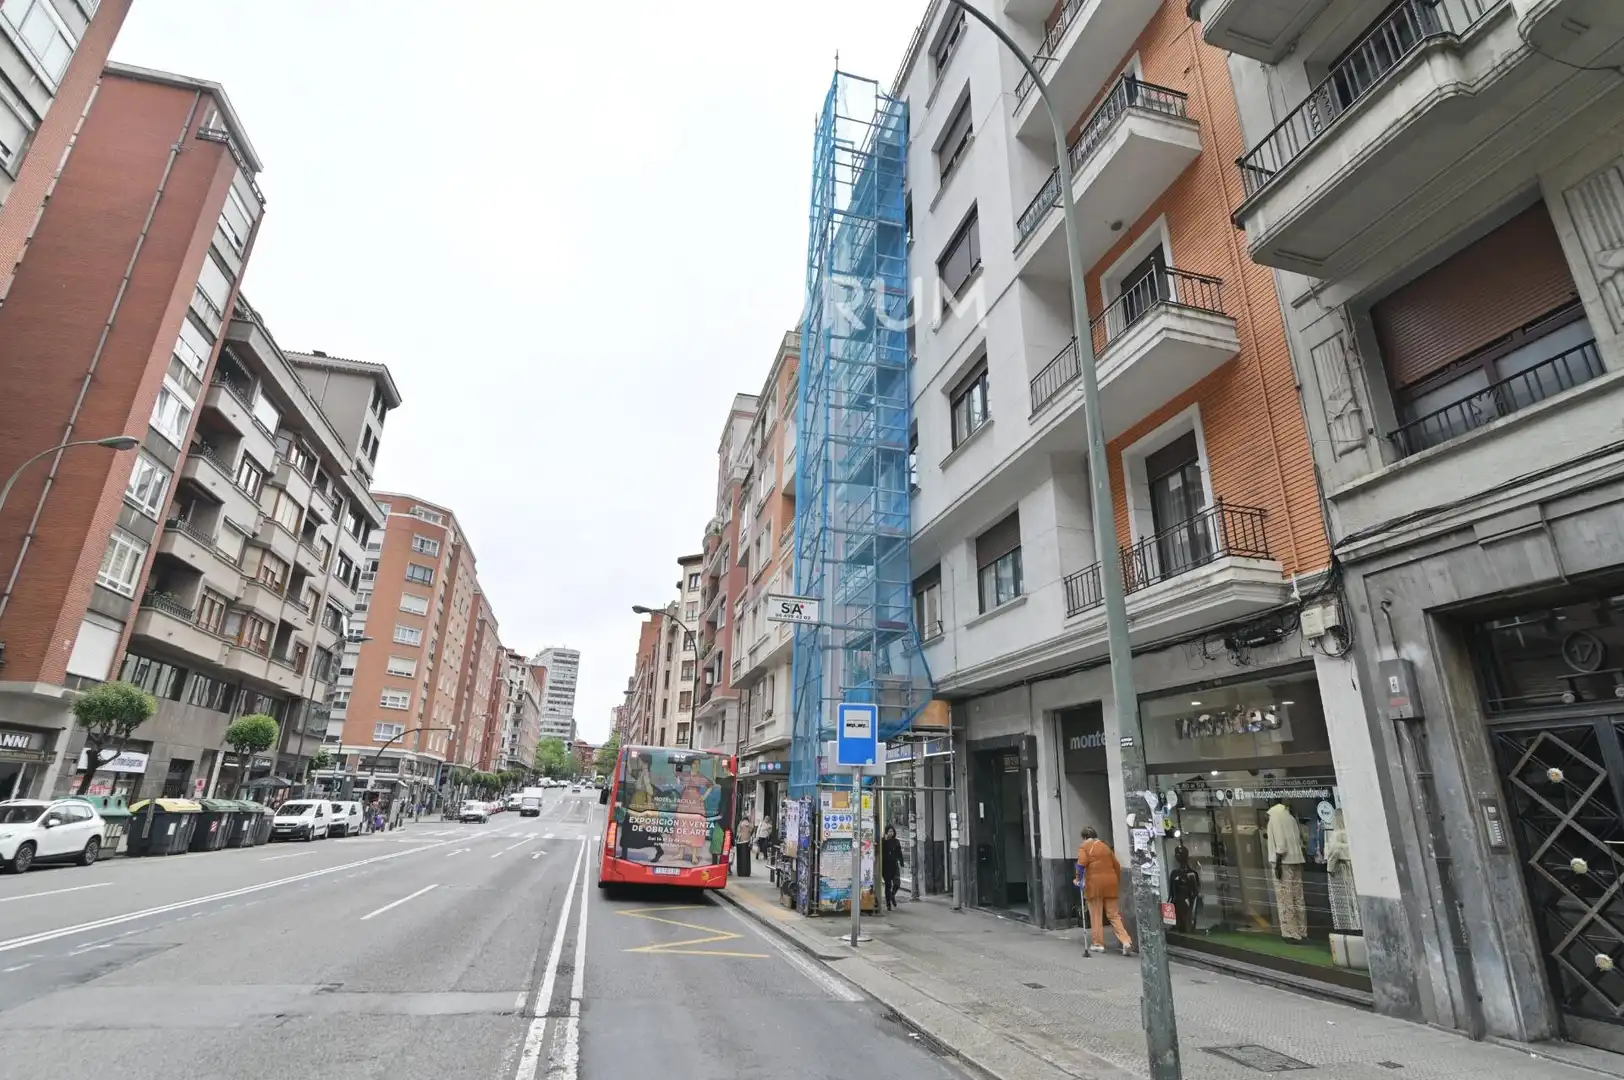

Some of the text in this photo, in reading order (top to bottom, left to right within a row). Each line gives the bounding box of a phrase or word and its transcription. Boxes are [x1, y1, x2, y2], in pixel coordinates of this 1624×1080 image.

[689, 821, 715, 829] VENTA
[646, 825, 674, 834] OBRAS
[676, 827, 688, 835] DE
[689, 829, 710, 837] ARTE
